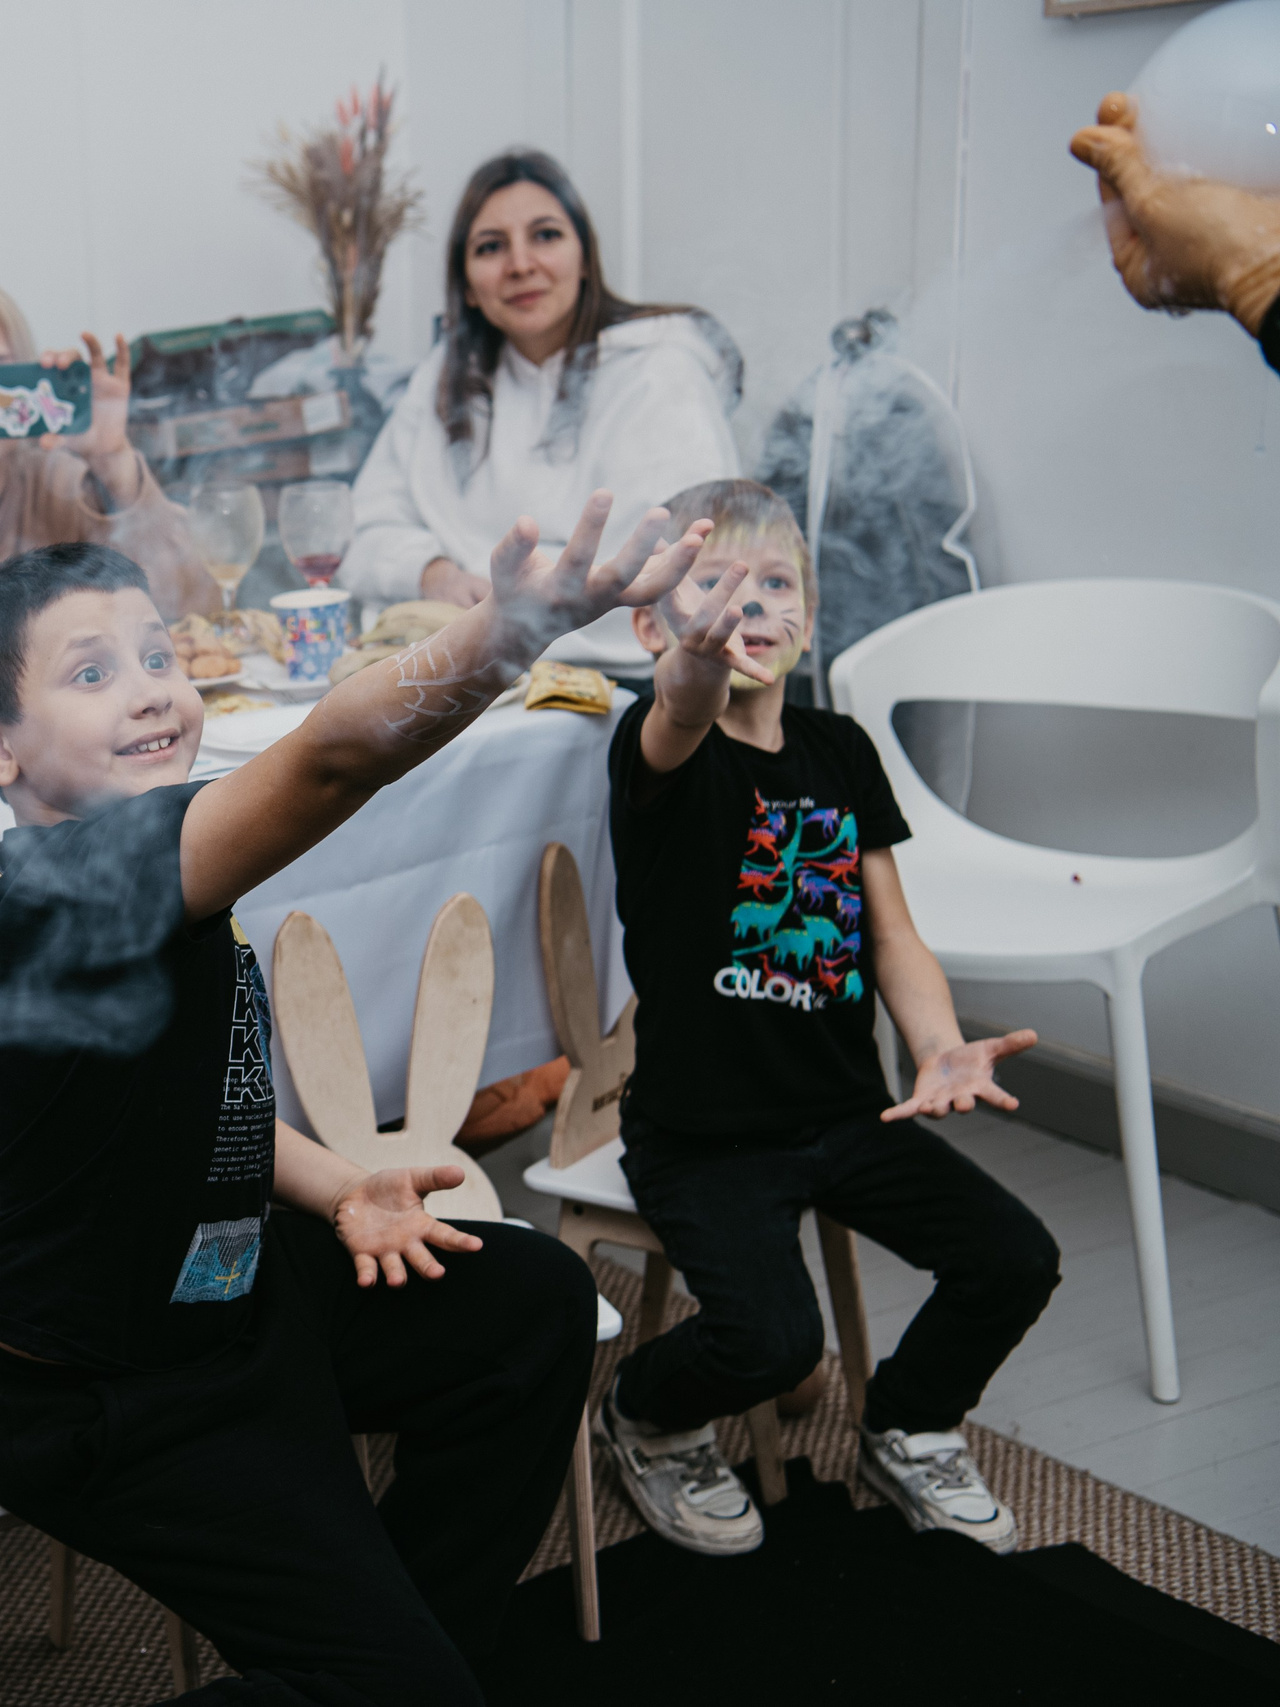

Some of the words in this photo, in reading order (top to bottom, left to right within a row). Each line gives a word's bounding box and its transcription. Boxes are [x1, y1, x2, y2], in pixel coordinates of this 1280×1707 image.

[799, 796, 815, 809] life
[713, 966, 812, 1012] COLOR
[224, 1066, 275, 1103] K
